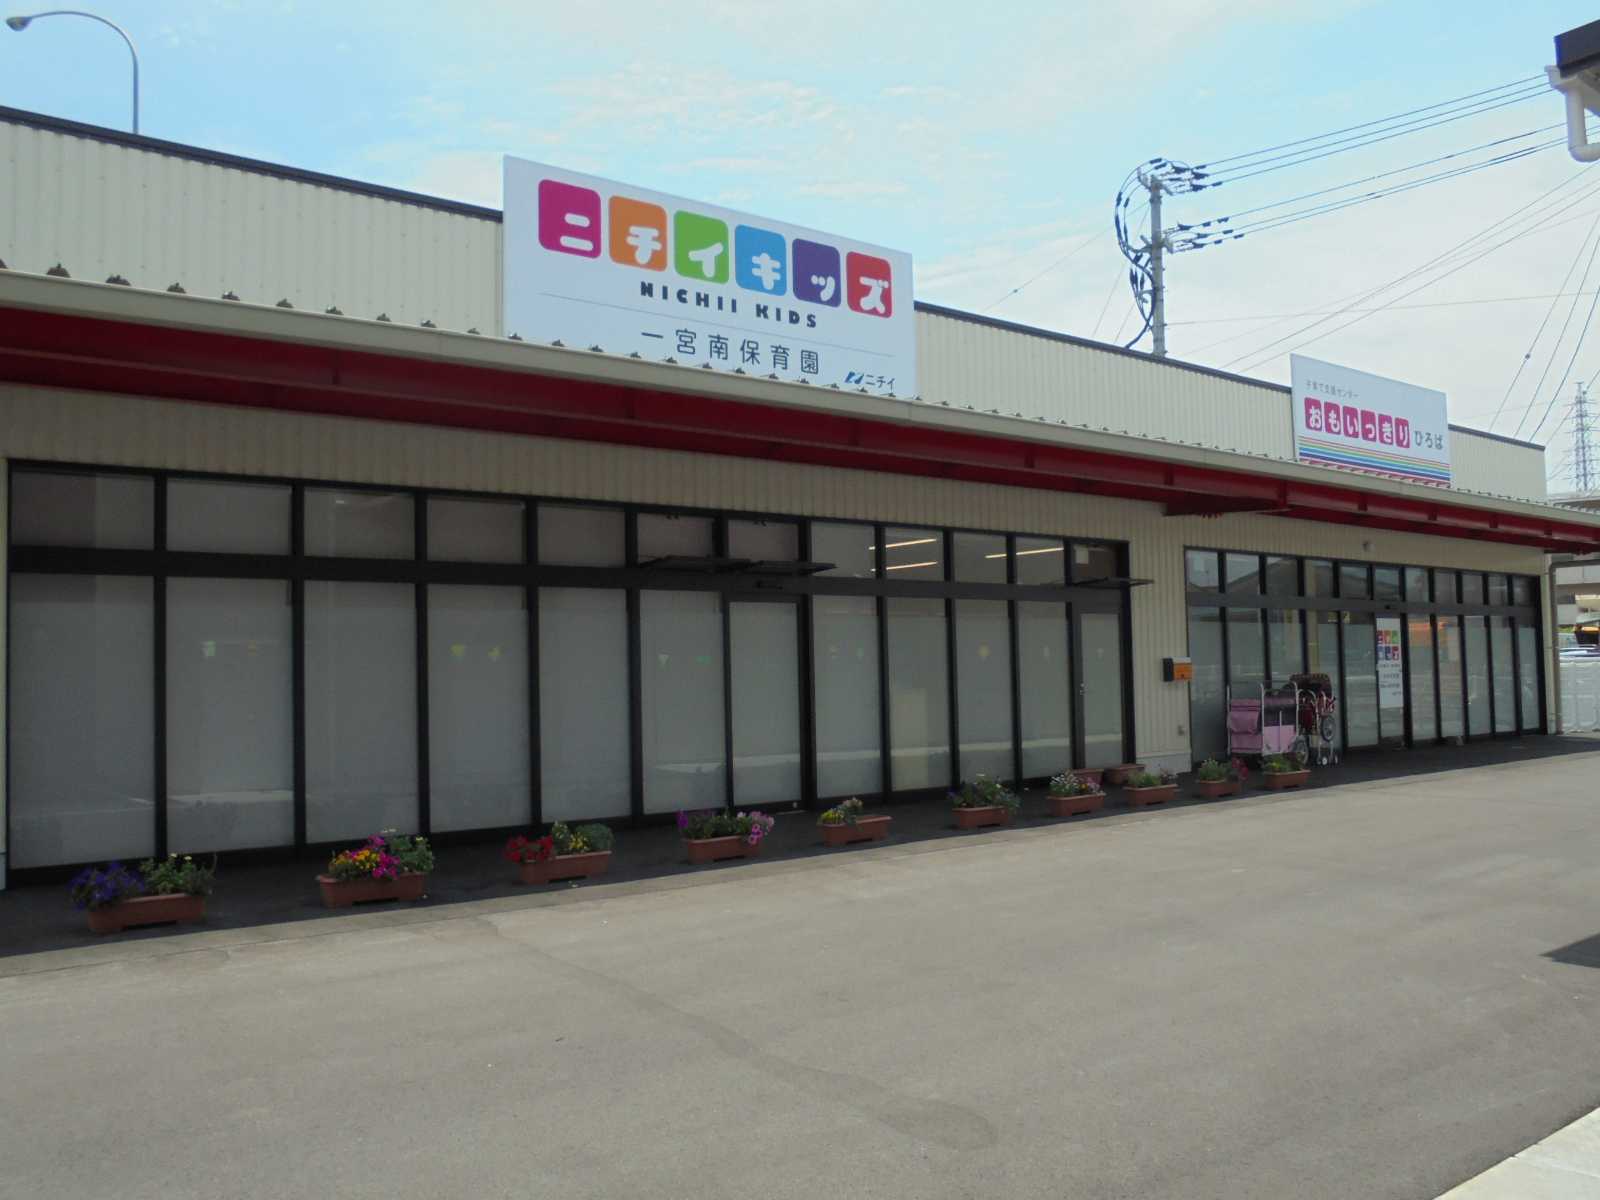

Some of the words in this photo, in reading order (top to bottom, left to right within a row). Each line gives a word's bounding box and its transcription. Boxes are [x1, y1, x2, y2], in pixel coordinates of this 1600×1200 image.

[552, 206, 890, 315] ニチイキッズ
[640, 281, 737, 313] NICHII
[755, 304, 817, 328] KIDS
[641, 328, 820, 375] 一宮南保育園
[865, 374, 896, 393] ニチイ
[1309, 403, 1408, 447] おもいっきり
